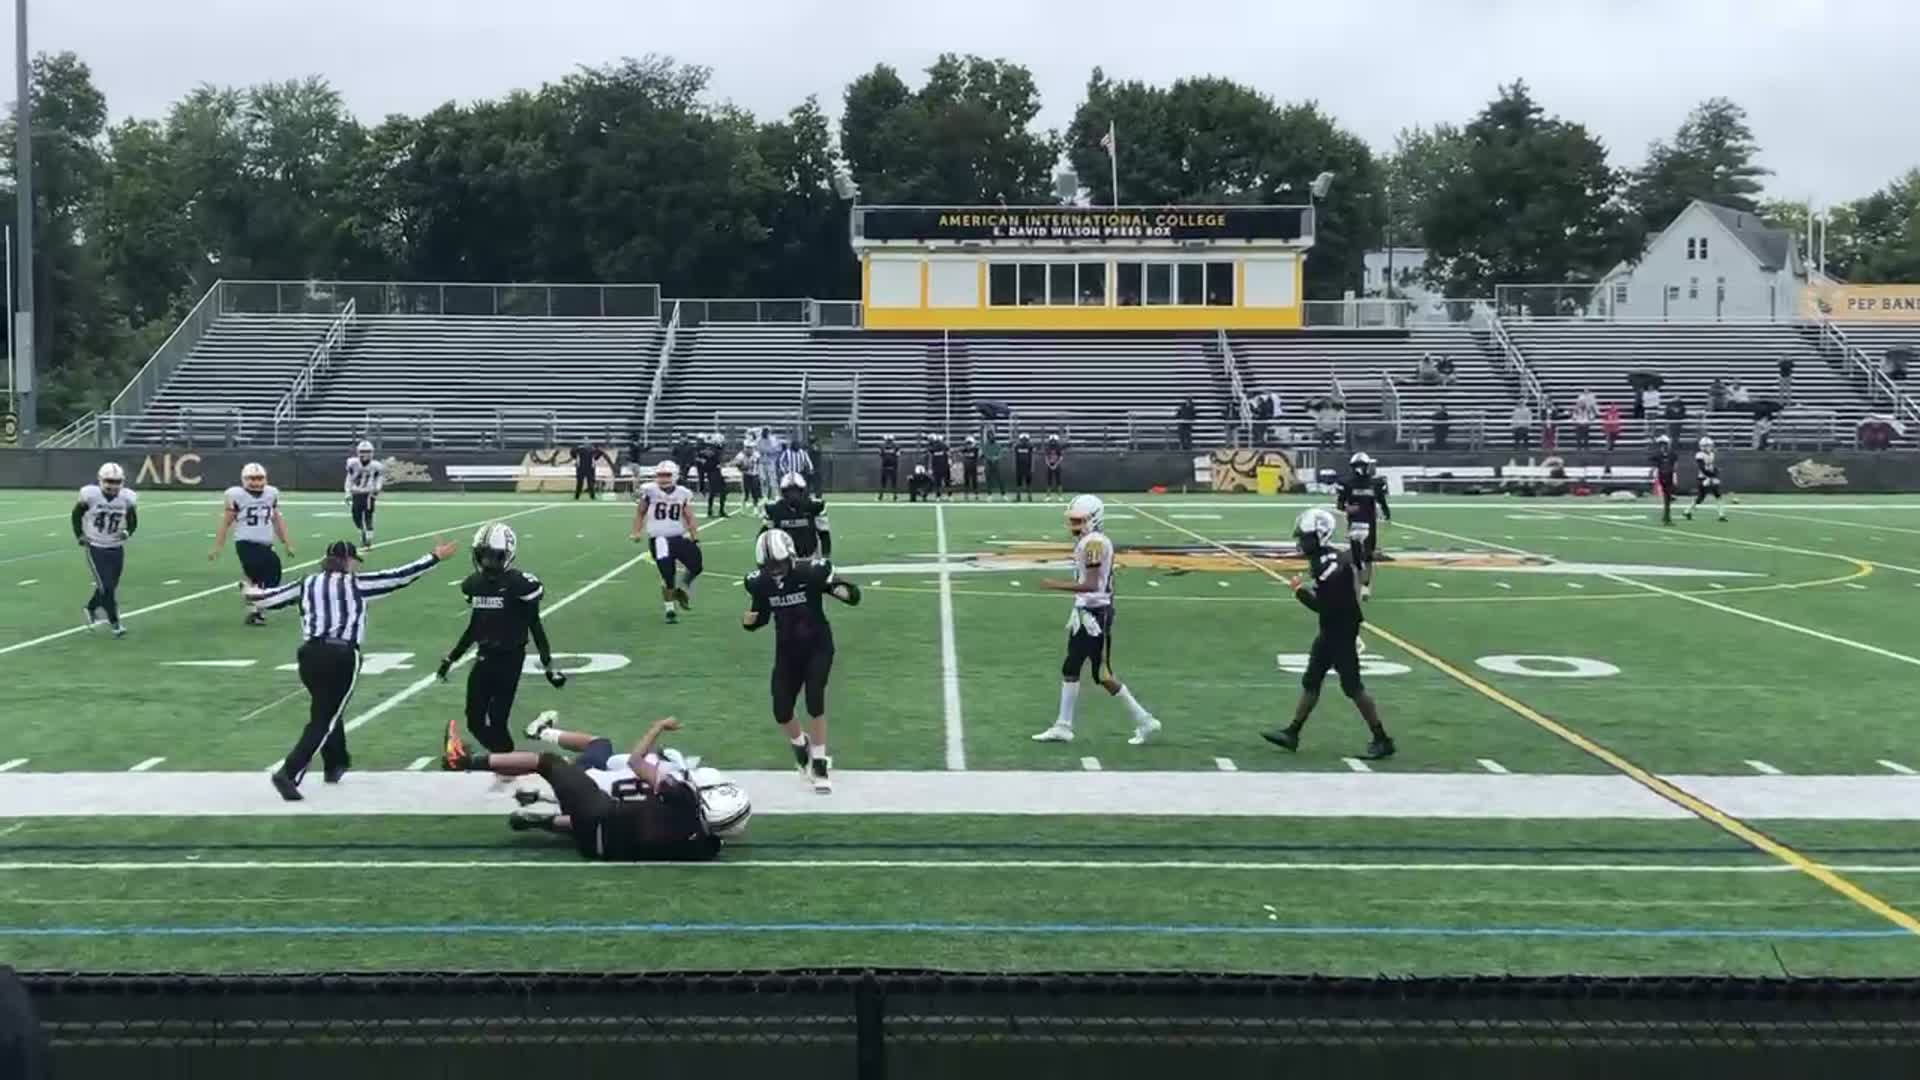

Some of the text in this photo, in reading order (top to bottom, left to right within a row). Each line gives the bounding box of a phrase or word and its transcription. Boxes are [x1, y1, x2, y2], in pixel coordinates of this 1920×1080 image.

[939, 214, 1226, 227] AMERICAN INTERNATIONAL COLLEGE
[1008, 227, 1047, 237] DAVID
[1051, 227, 1101, 237] WILSON
[1104, 227, 1142, 236] PRESS
[1146, 227, 1171, 236] BOX
[1848, 298, 1920, 310] PEP BAN
[136, 453, 202, 484] AIC
[247, 505, 272, 526] 57
[654, 501, 681, 521] 60
[93, 511, 122, 535] 46
